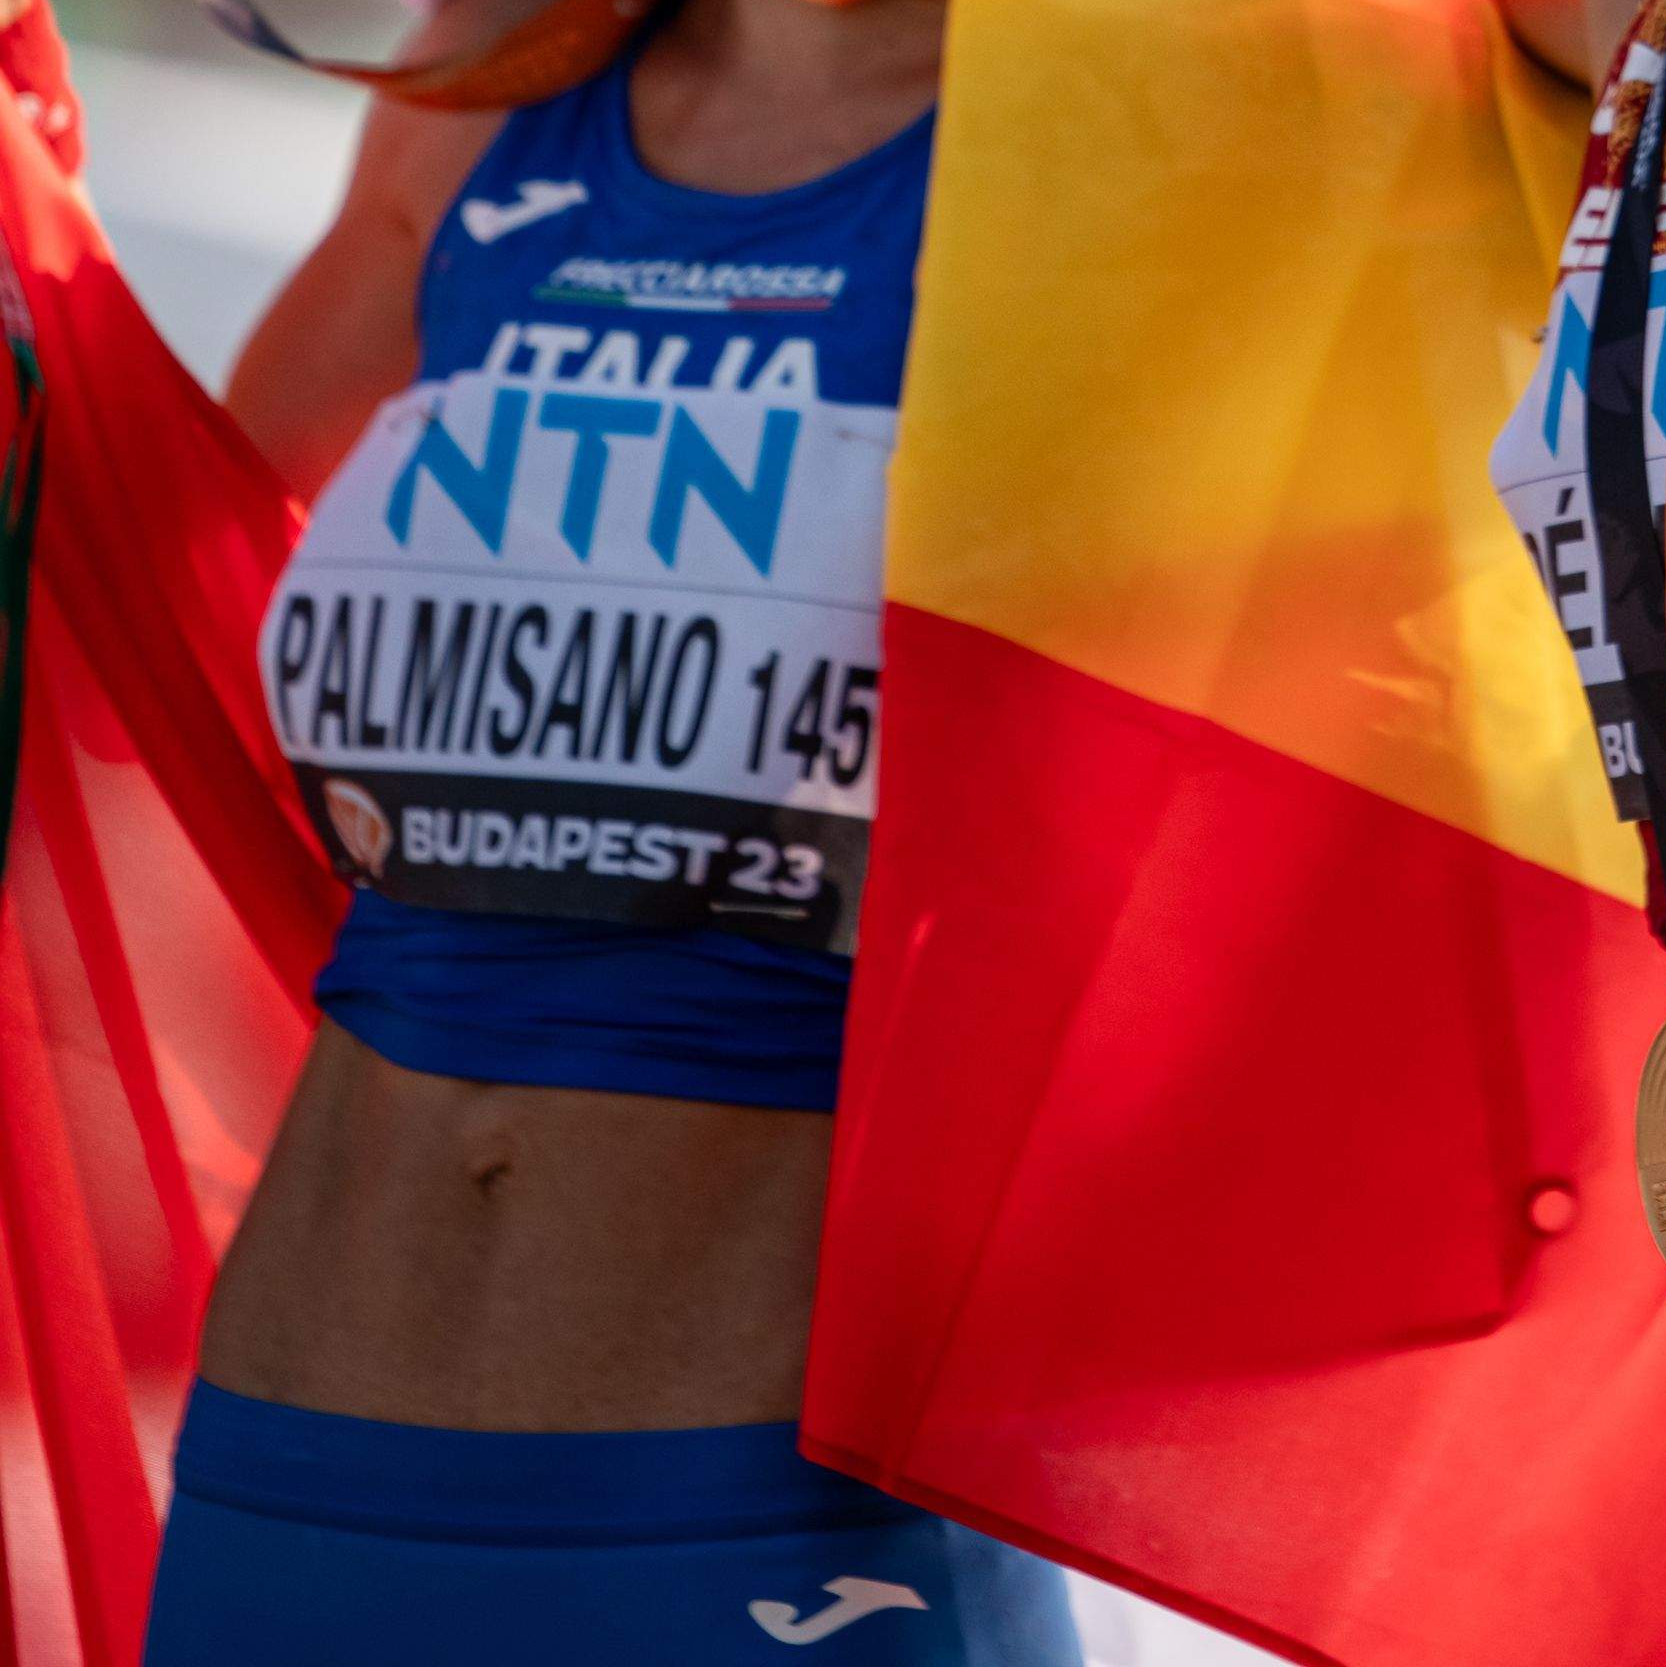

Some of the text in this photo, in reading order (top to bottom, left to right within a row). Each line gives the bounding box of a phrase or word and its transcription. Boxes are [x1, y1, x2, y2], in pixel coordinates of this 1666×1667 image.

[383, 386, 801, 578] NTN
[274, 595, 883, 789] PALMISANO 145
[402, 805, 827, 899] BUDAPEST 23
